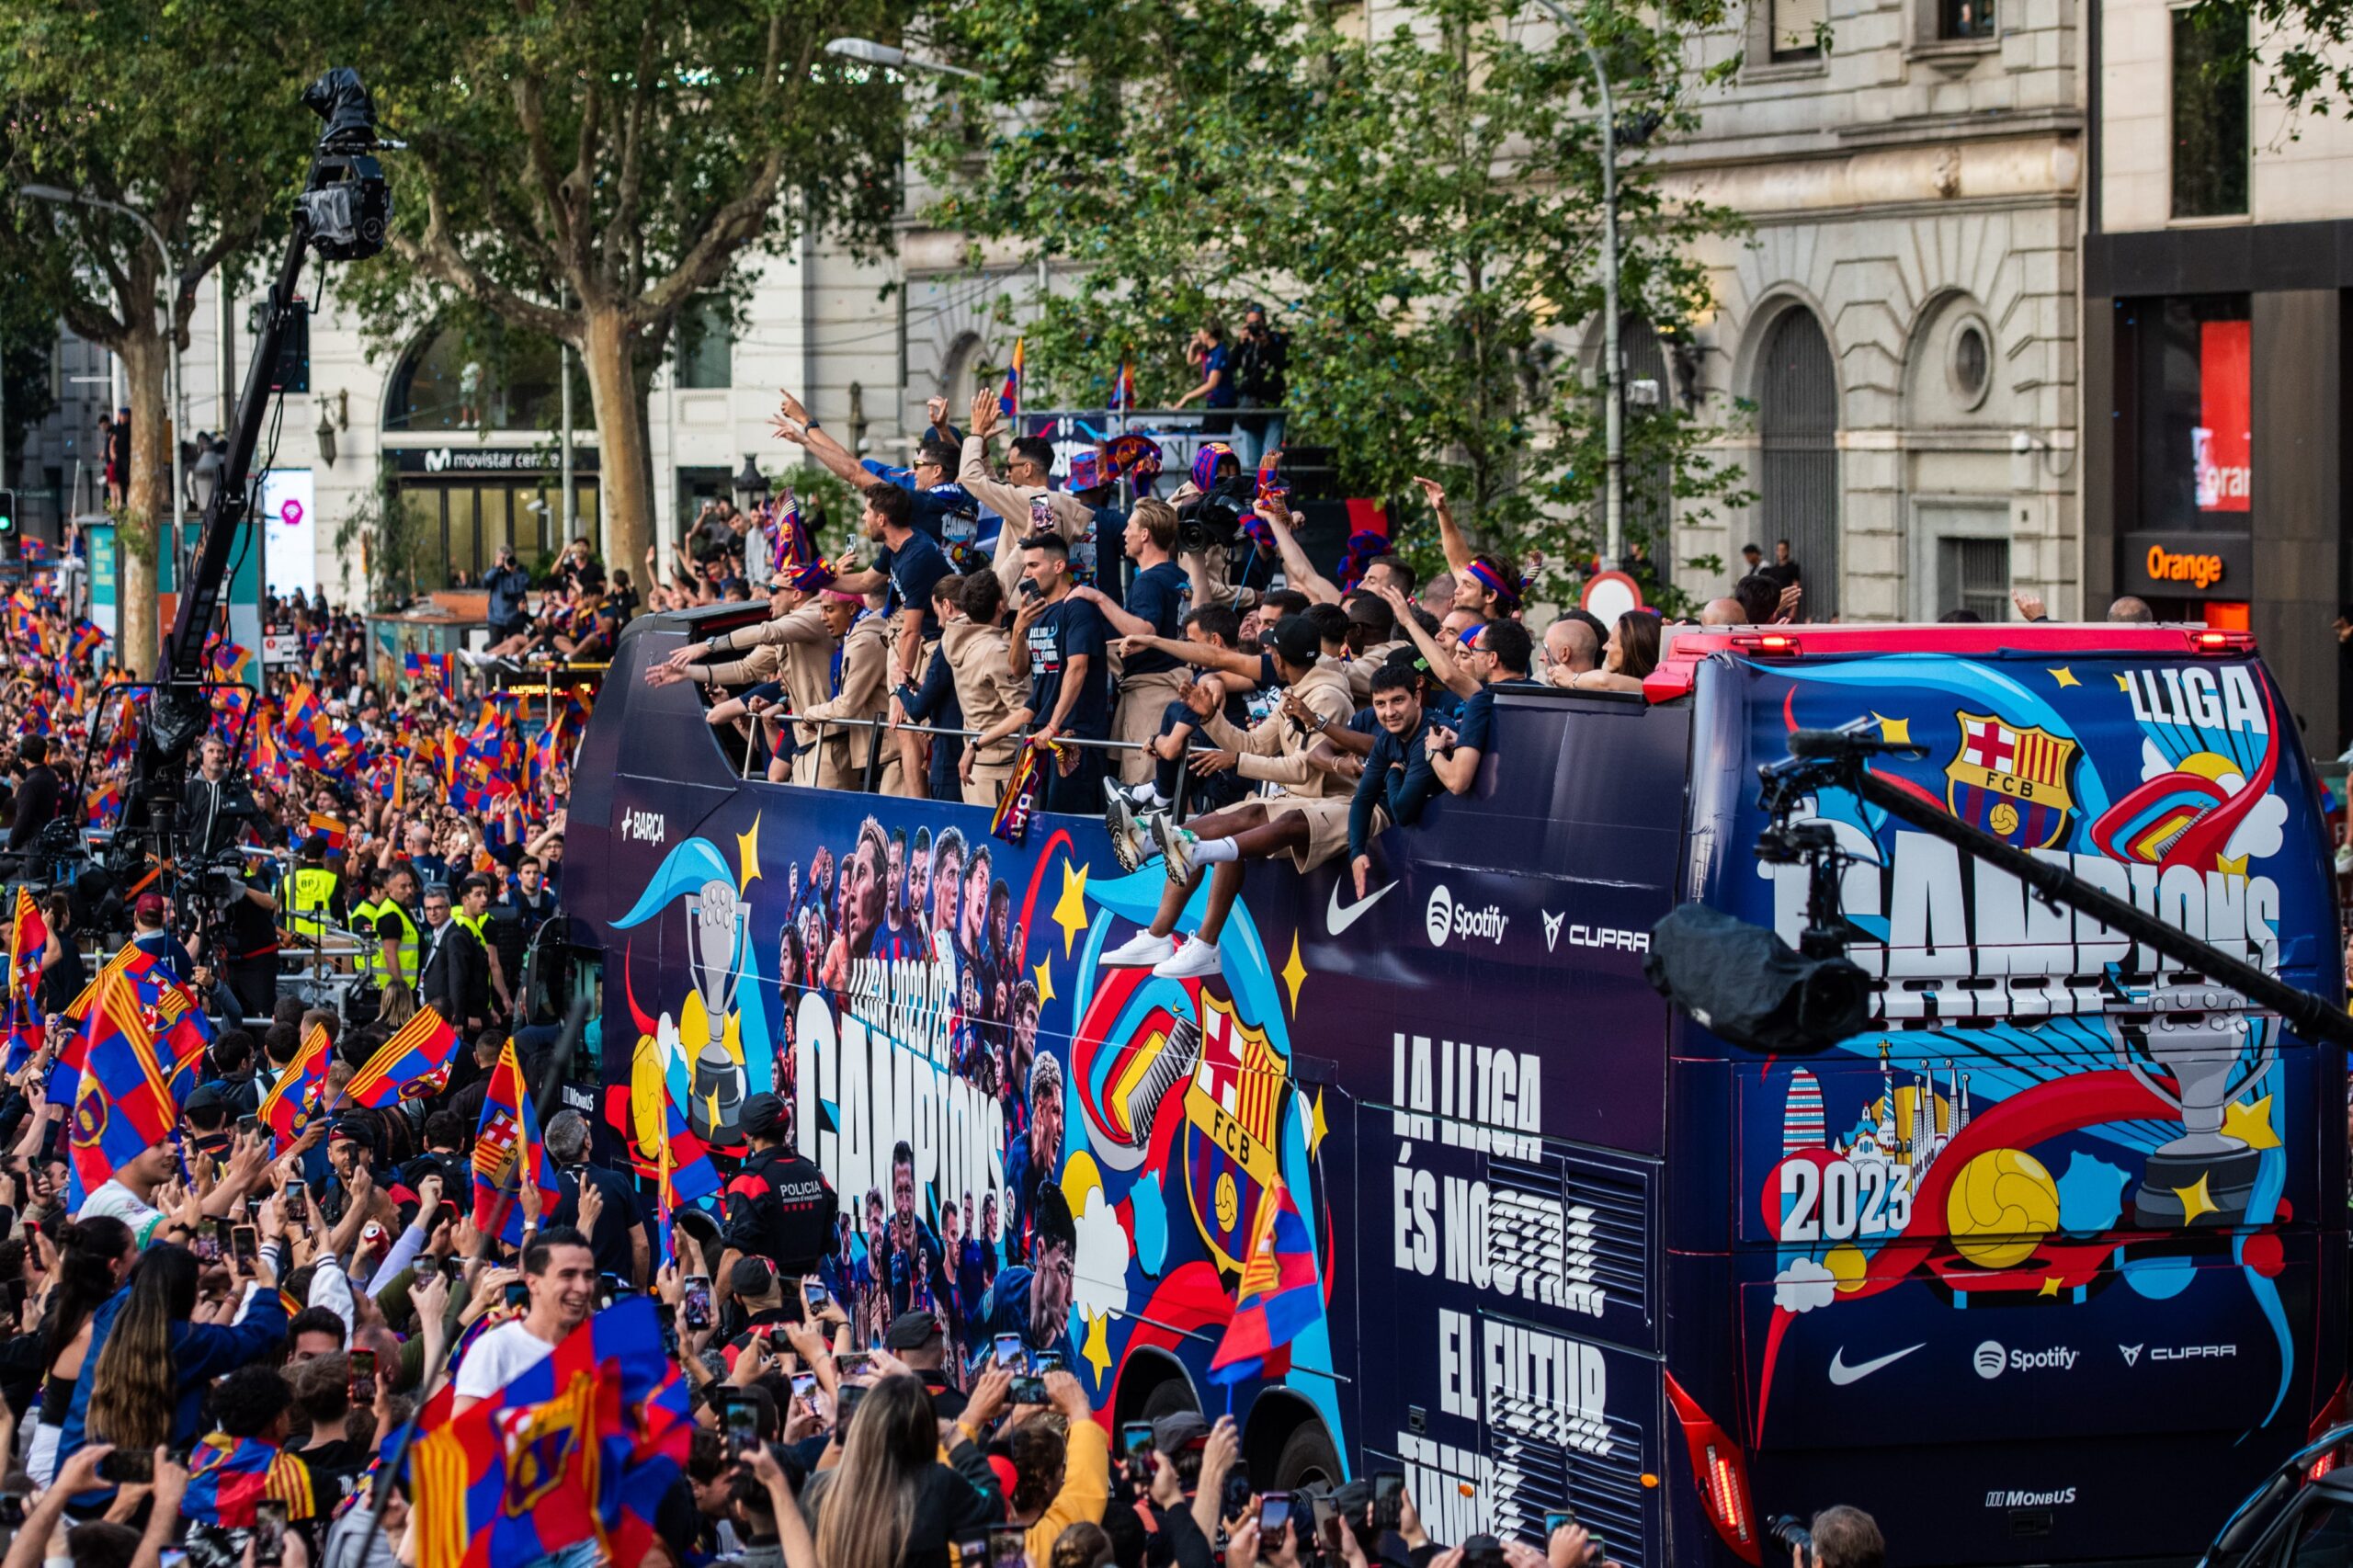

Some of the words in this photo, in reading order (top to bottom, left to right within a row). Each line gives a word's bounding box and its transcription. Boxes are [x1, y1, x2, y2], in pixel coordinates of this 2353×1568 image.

[453, 450, 513, 469] movistar
[515, 452, 560, 469] cene
[2147, 544, 2222, 589] Orange
[2124, 665, 2268, 735] LLIGA
[1986, 771, 2033, 798] FCB
[633, 811, 664, 846] BARÇA
[1454, 903, 1507, 945] Spotify
[1569, 925, 1650, 953] CUPRA
[848, 958, 889, 1037] LLIGA
[890, 959, 951, 1070] 2022/23
[796, 992, 1005, 1243] CAMPIONS
[1393, 1032, 1433, 1142] LA
[1441, 1040, 1541, 1164] LLIGA
[1213, 1108, 1250, 1165] FCB
[779, 1180, 822, 1197] POLICIA
[1393, 1141, 1438, 1276] ÉS
[1780, 1158, 1912, 1242] 2023
[2010, 1346, 2076, 1371] Spotify
[2151, 1345, 2236, 1360] CUPRA
[1438, 1308, 1478, 1421] EL
[1483, 1319, 1615, 1454] FUTUR
